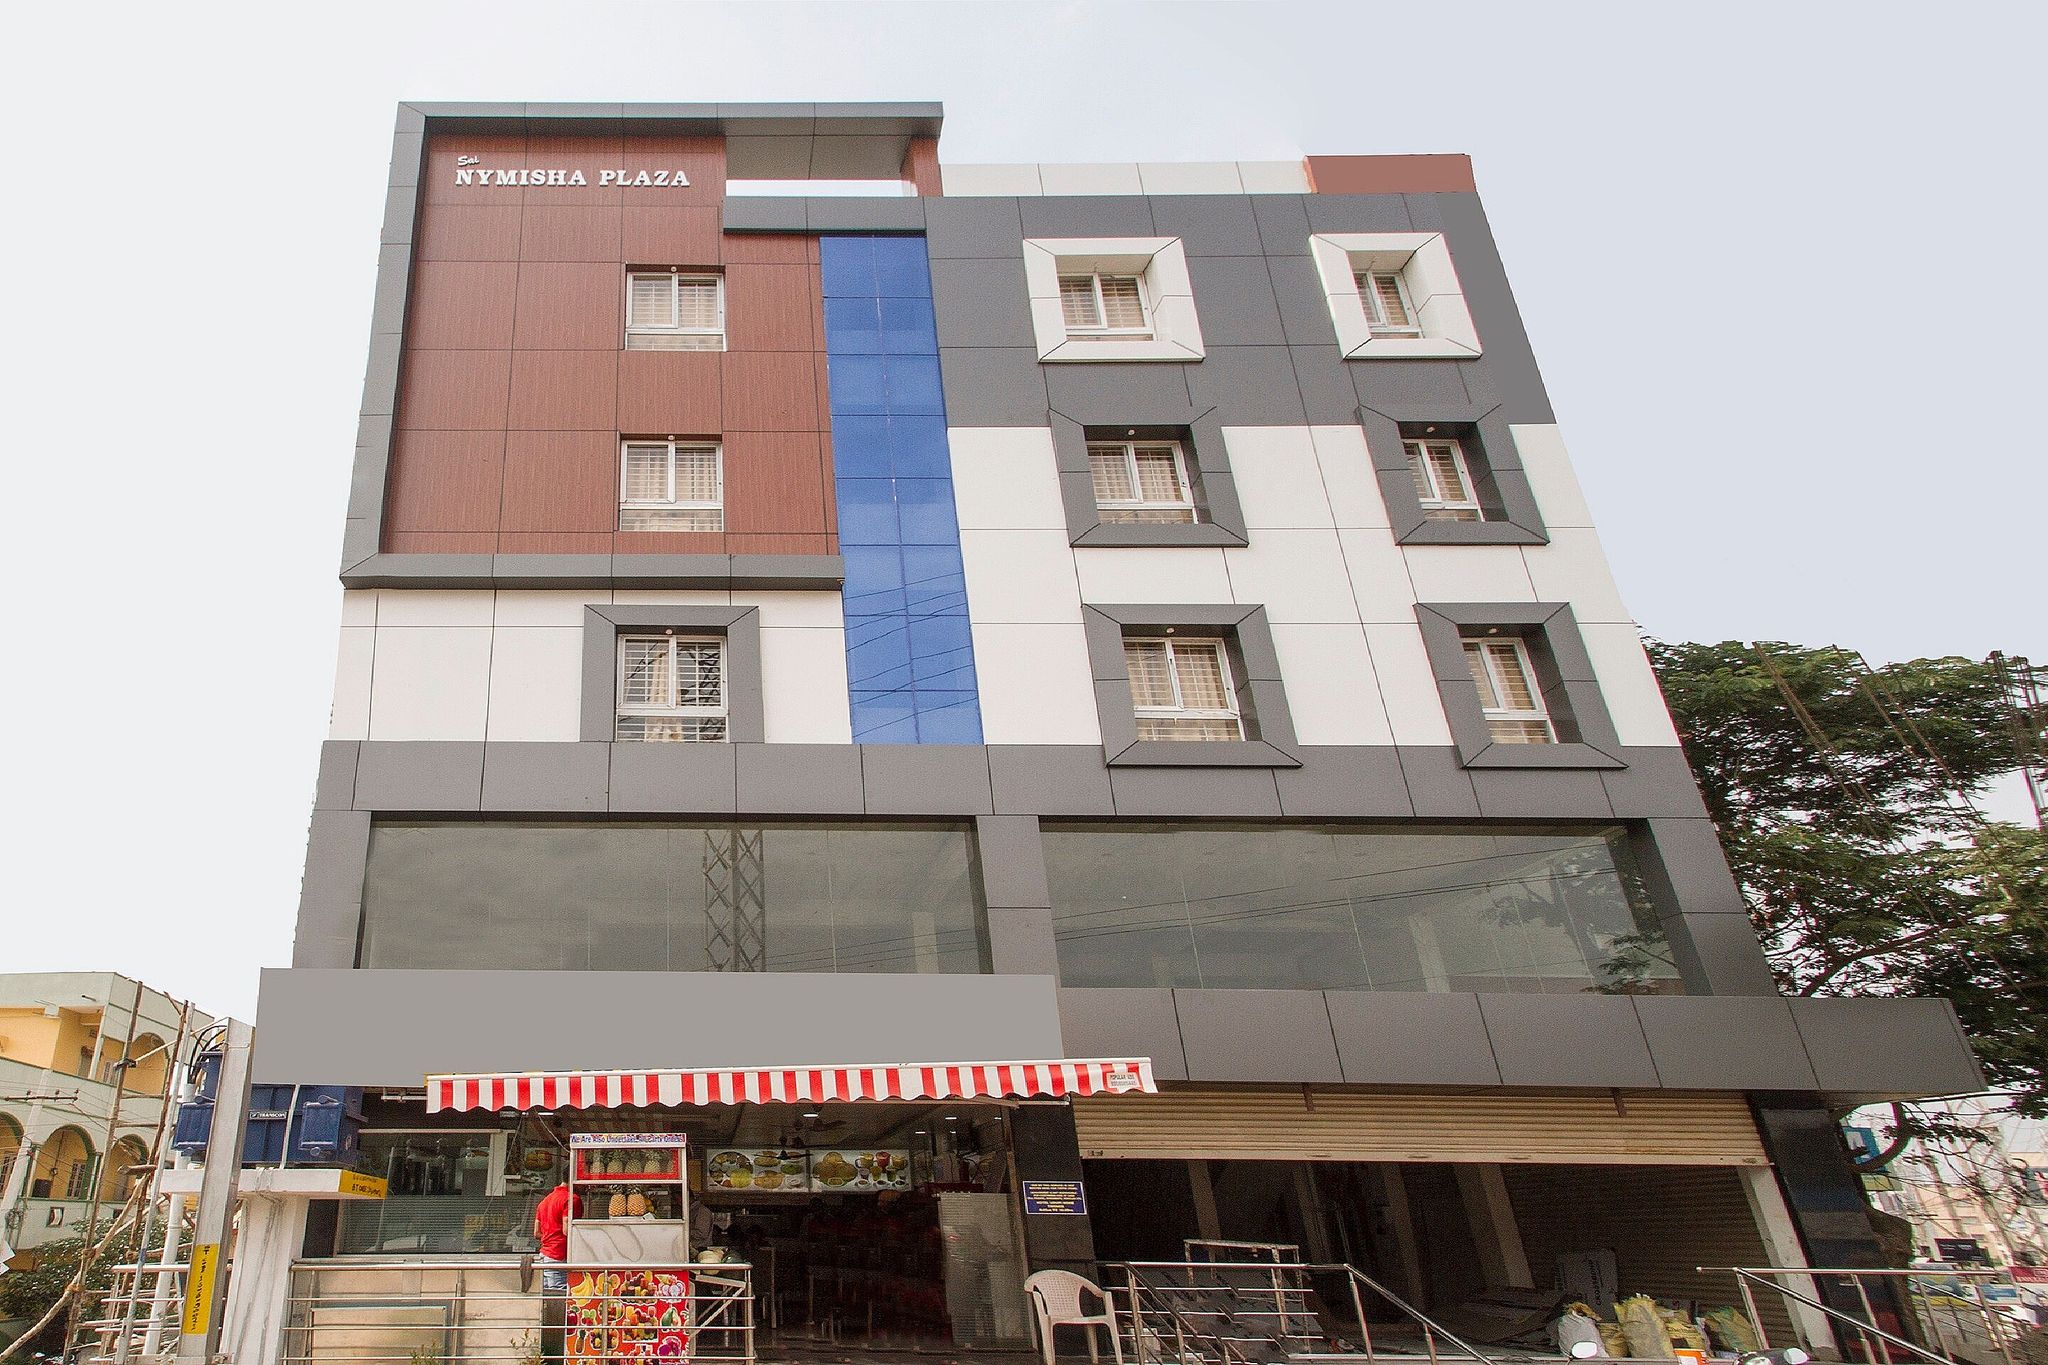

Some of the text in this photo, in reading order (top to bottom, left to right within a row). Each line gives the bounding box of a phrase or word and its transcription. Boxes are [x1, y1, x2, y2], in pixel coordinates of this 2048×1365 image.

[457, 155, 480, 167] Sai
[455, 169, 690, 187] NYMISHA PLAZA
